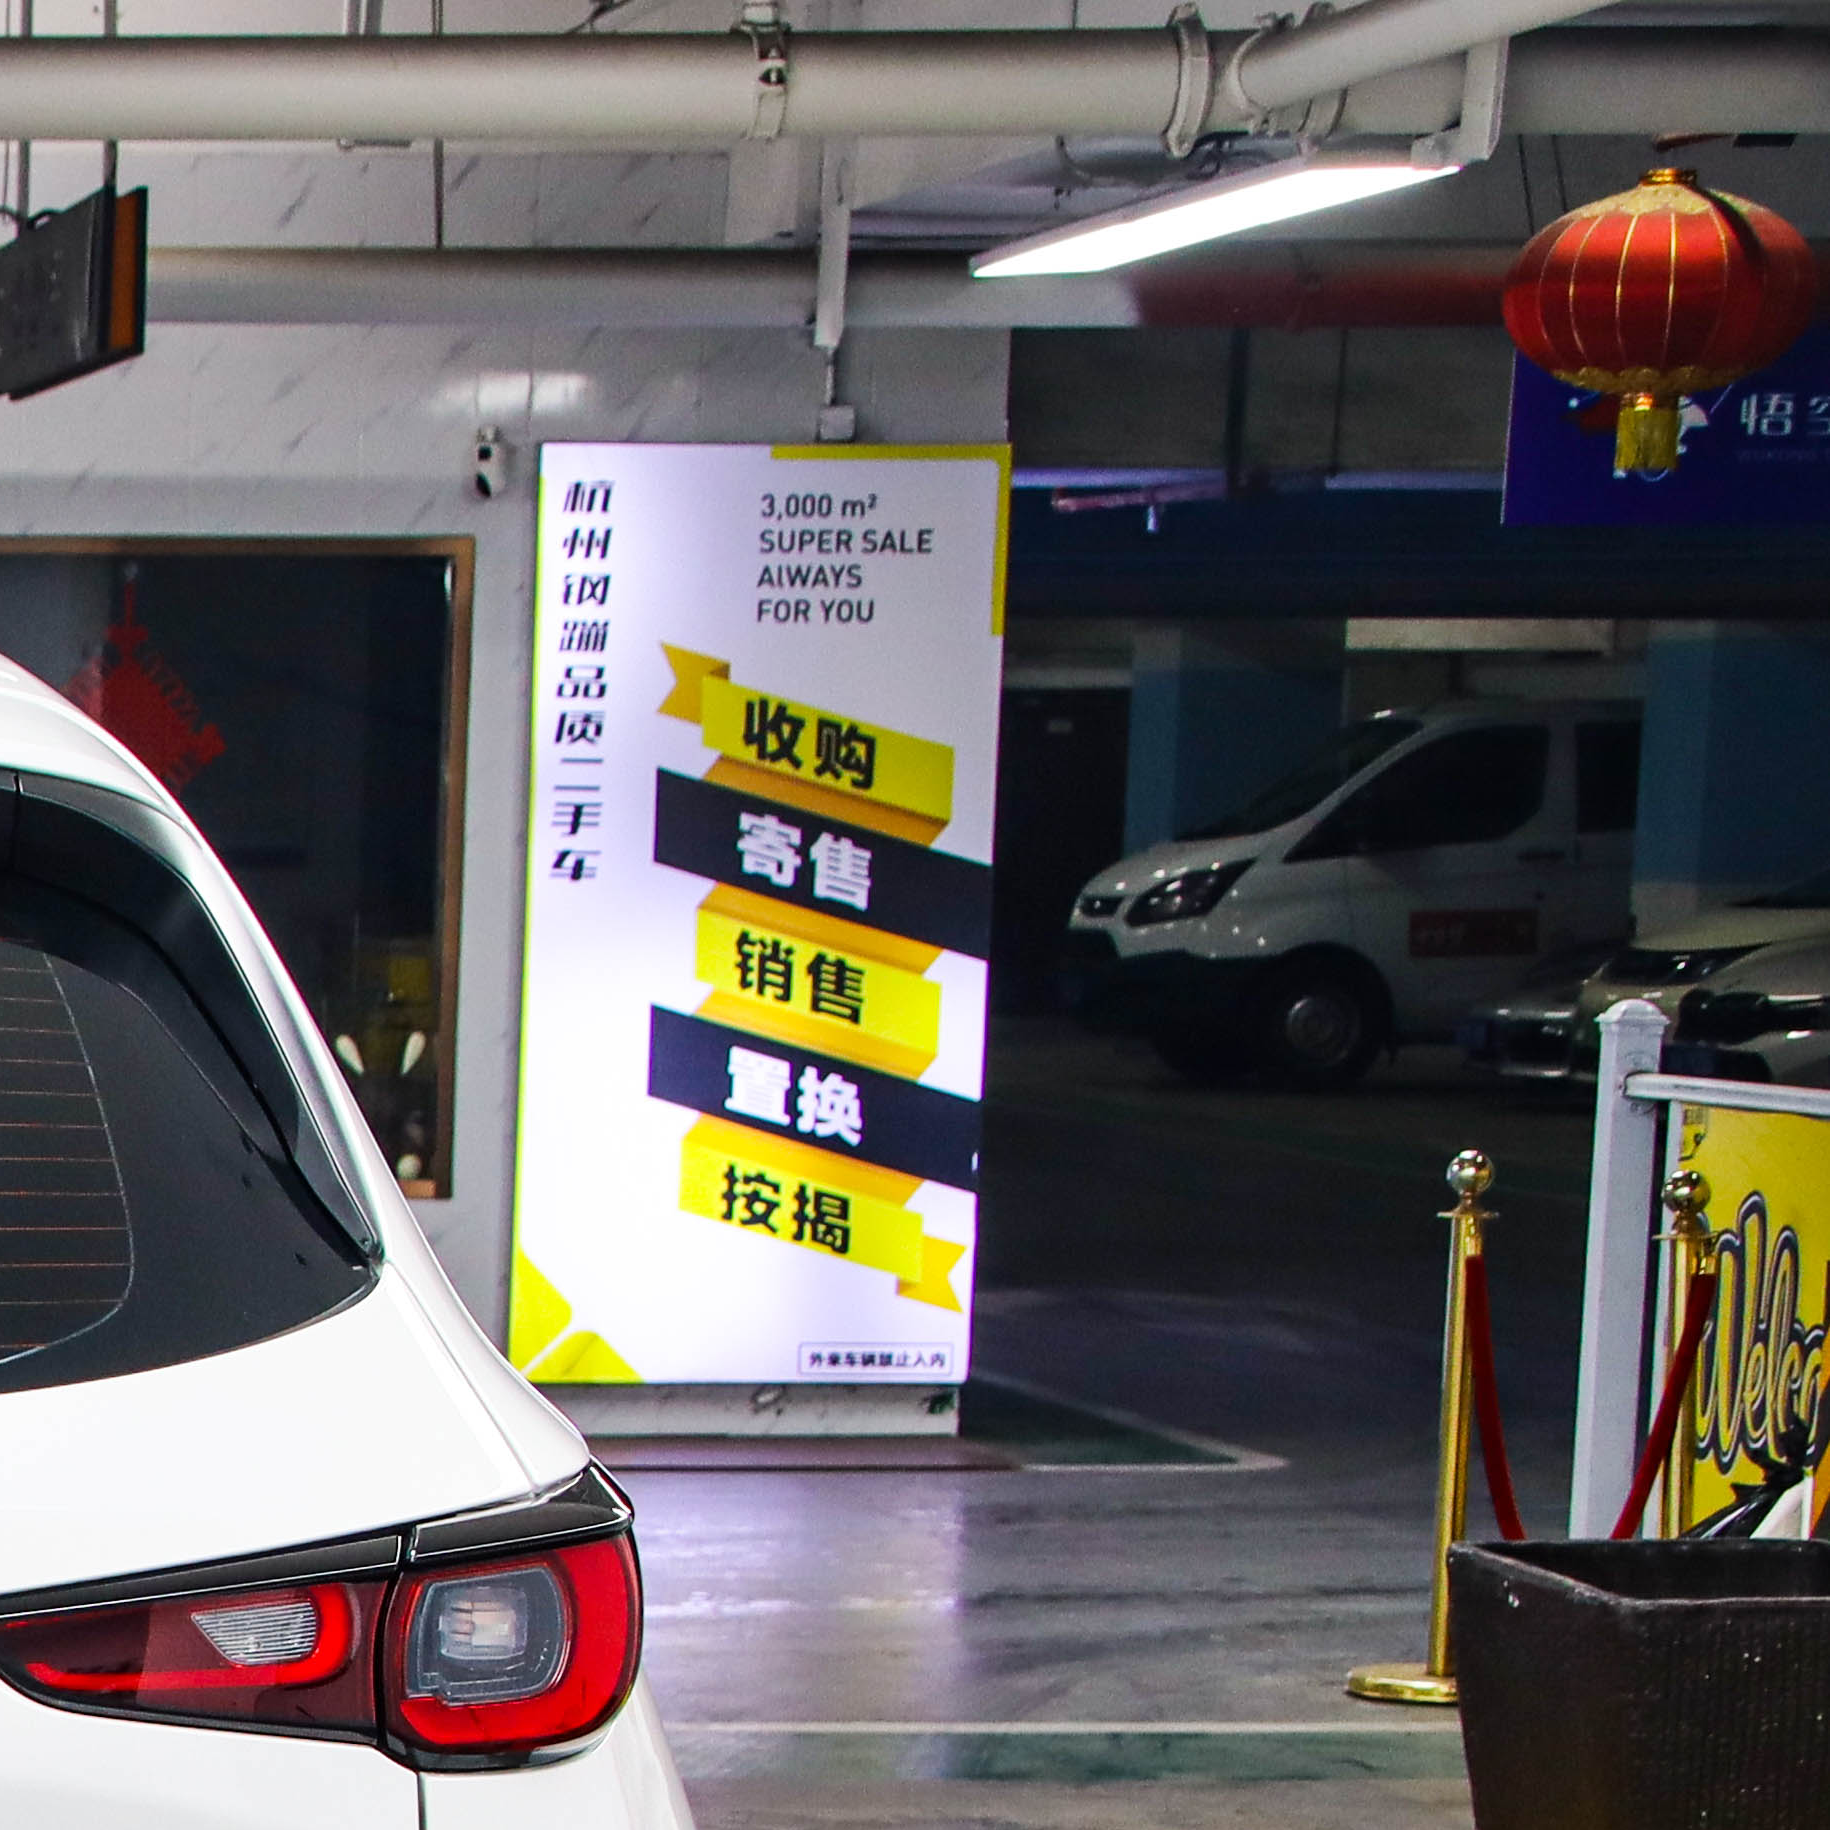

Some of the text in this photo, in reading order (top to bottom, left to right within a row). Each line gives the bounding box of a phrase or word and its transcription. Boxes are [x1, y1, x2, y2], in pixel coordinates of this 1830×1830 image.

[758, 528, 934, 554] SUPER SALE
[760, 492, 833, 521] 3,000
[756, 599, 875, 624] FOR YOU
[742, 697, 877, 790] 收购
[737, 811, 873, 913] 寄售
[735, 928, 865, 1025] 销售
[723, 1044, 863, 1148] 置换
[721, 1163, 852, 1256] 按揭
